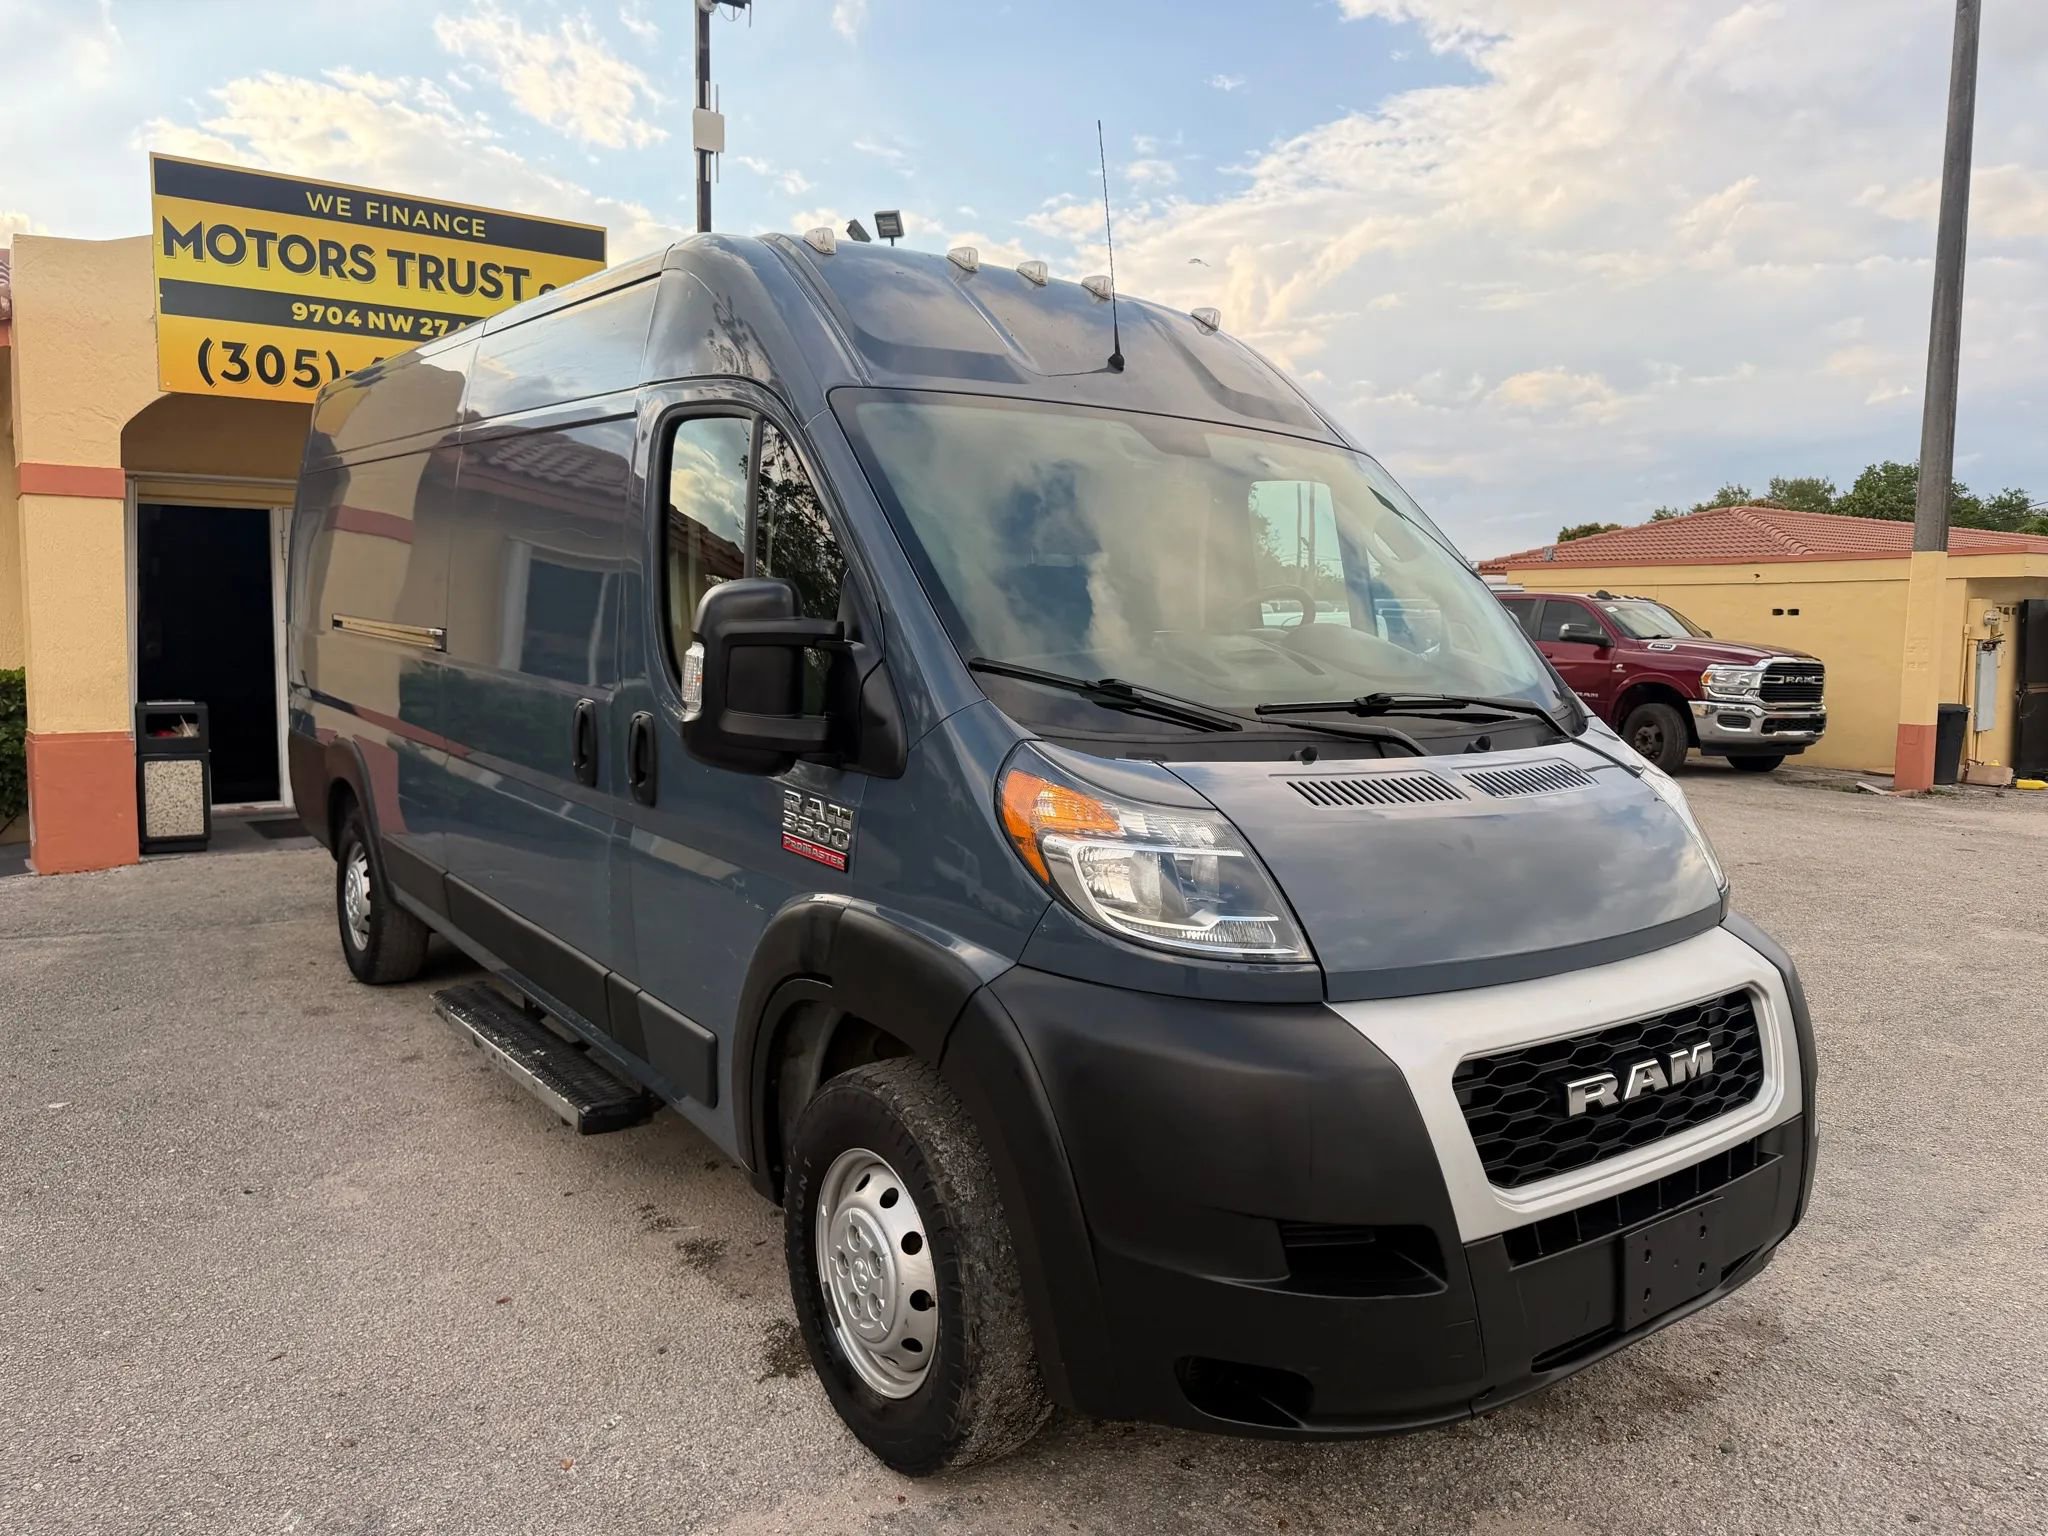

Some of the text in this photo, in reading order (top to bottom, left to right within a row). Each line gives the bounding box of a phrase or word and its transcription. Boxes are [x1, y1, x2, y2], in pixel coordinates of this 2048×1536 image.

[305, 191, 487, 238] WE FINANCE
[161, 215, 533, 303] MOTORS TRUST
[291, 302, 362, 328] 9704
[367, 311, 414, 333] NW
[419, 317, 449, 337] 27
[1785, 675, 1816, 685] RAM
[782, 809, 850, 851] 3500
[783, 789, 855, 831] RAM
[1566, 1041, 1714, 1117] RAM
